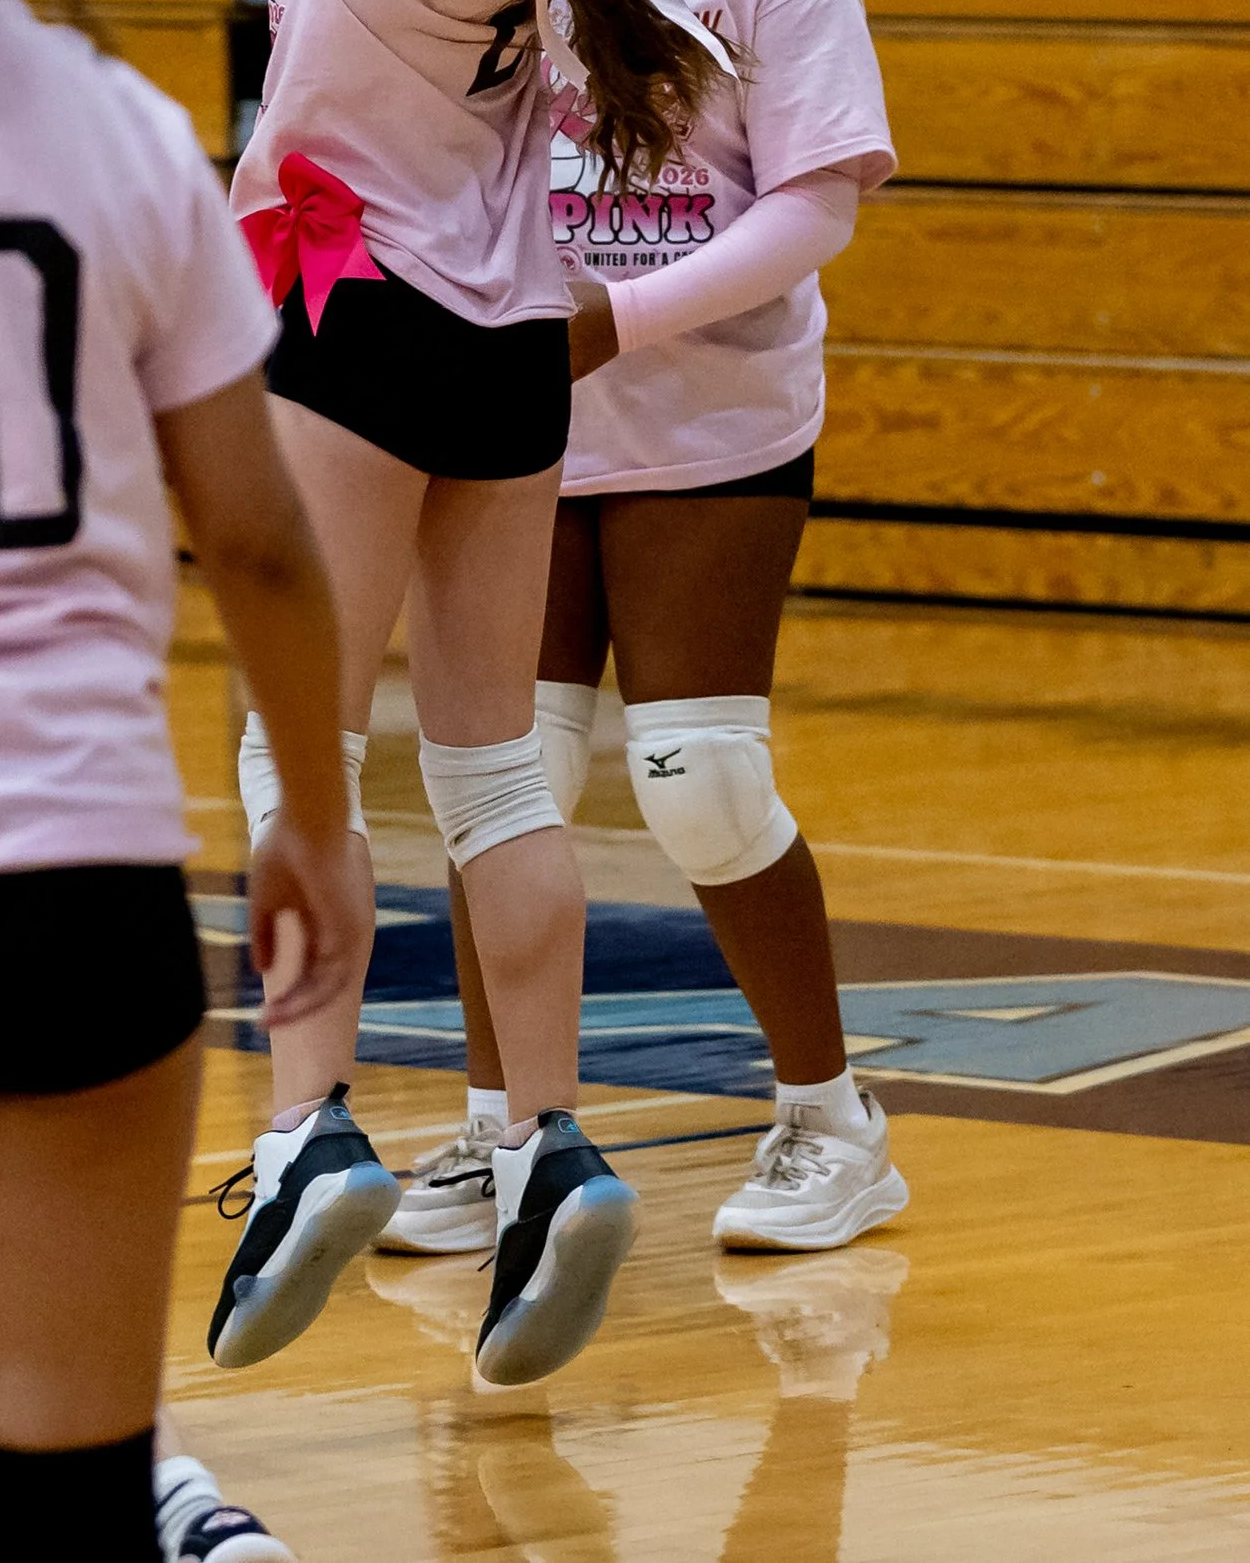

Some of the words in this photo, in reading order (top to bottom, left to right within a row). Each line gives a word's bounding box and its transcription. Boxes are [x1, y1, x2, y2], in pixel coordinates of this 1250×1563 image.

[654, 167, 709, 186] 026
[549, 192, 715, 245] PINK
[584, 253, 627, 266] UNITED
[633, 253, 656, 266] FOR
[661, 253, 669, 266] A
